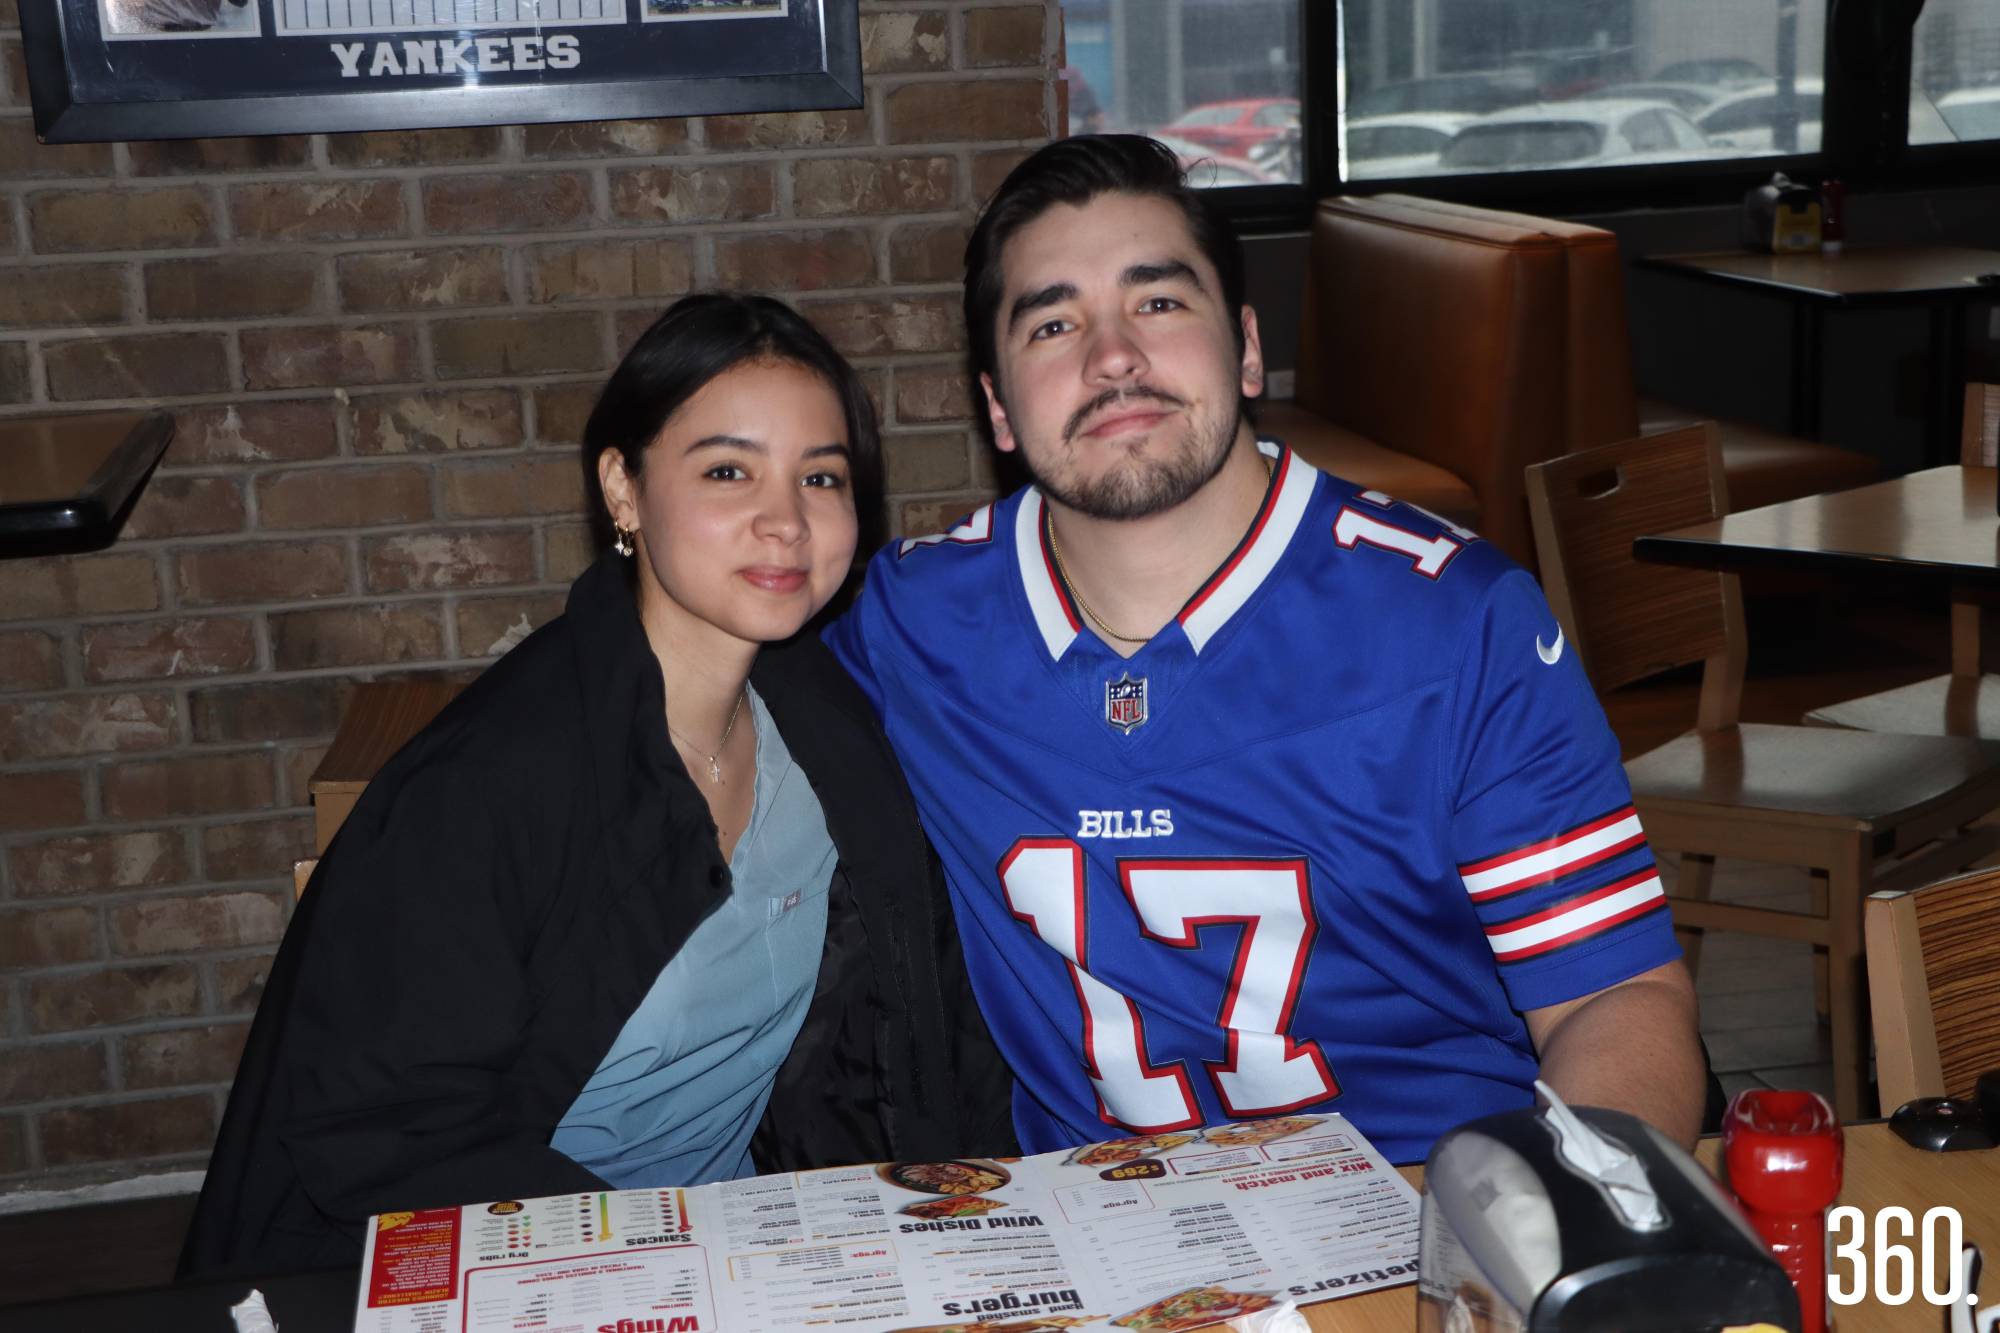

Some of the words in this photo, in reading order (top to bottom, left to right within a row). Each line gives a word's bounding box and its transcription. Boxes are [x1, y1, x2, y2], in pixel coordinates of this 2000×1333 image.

[331, 34, 580, 77] YANKEES
[1111, 700, 1141, 722] NFL
[1077, 809, 1174, 839] BILLS
[996, 834, 1343, 1134] 17
[1300, 1167, 1336, 1180] and
[1338, 1161, 1374, 1173] Mix
[1235, 1173, 1296, 1191] match
[899, 1219, 981, 1234] Dishes
[986, 1215, 1044, 1229] Wild
[625, 1233, 692, 1246] Sauces
[479, 1253, 505, 1262] rubs
[508, 1251, 529, 1260] Dry
[1287, 1259, 1420, 1297] petizers
[942, 1289, 1080, 1316] burgers
[1048, 1302, 1084, 1314] Hand
[976, 1308, 1040, 1322] smashed
